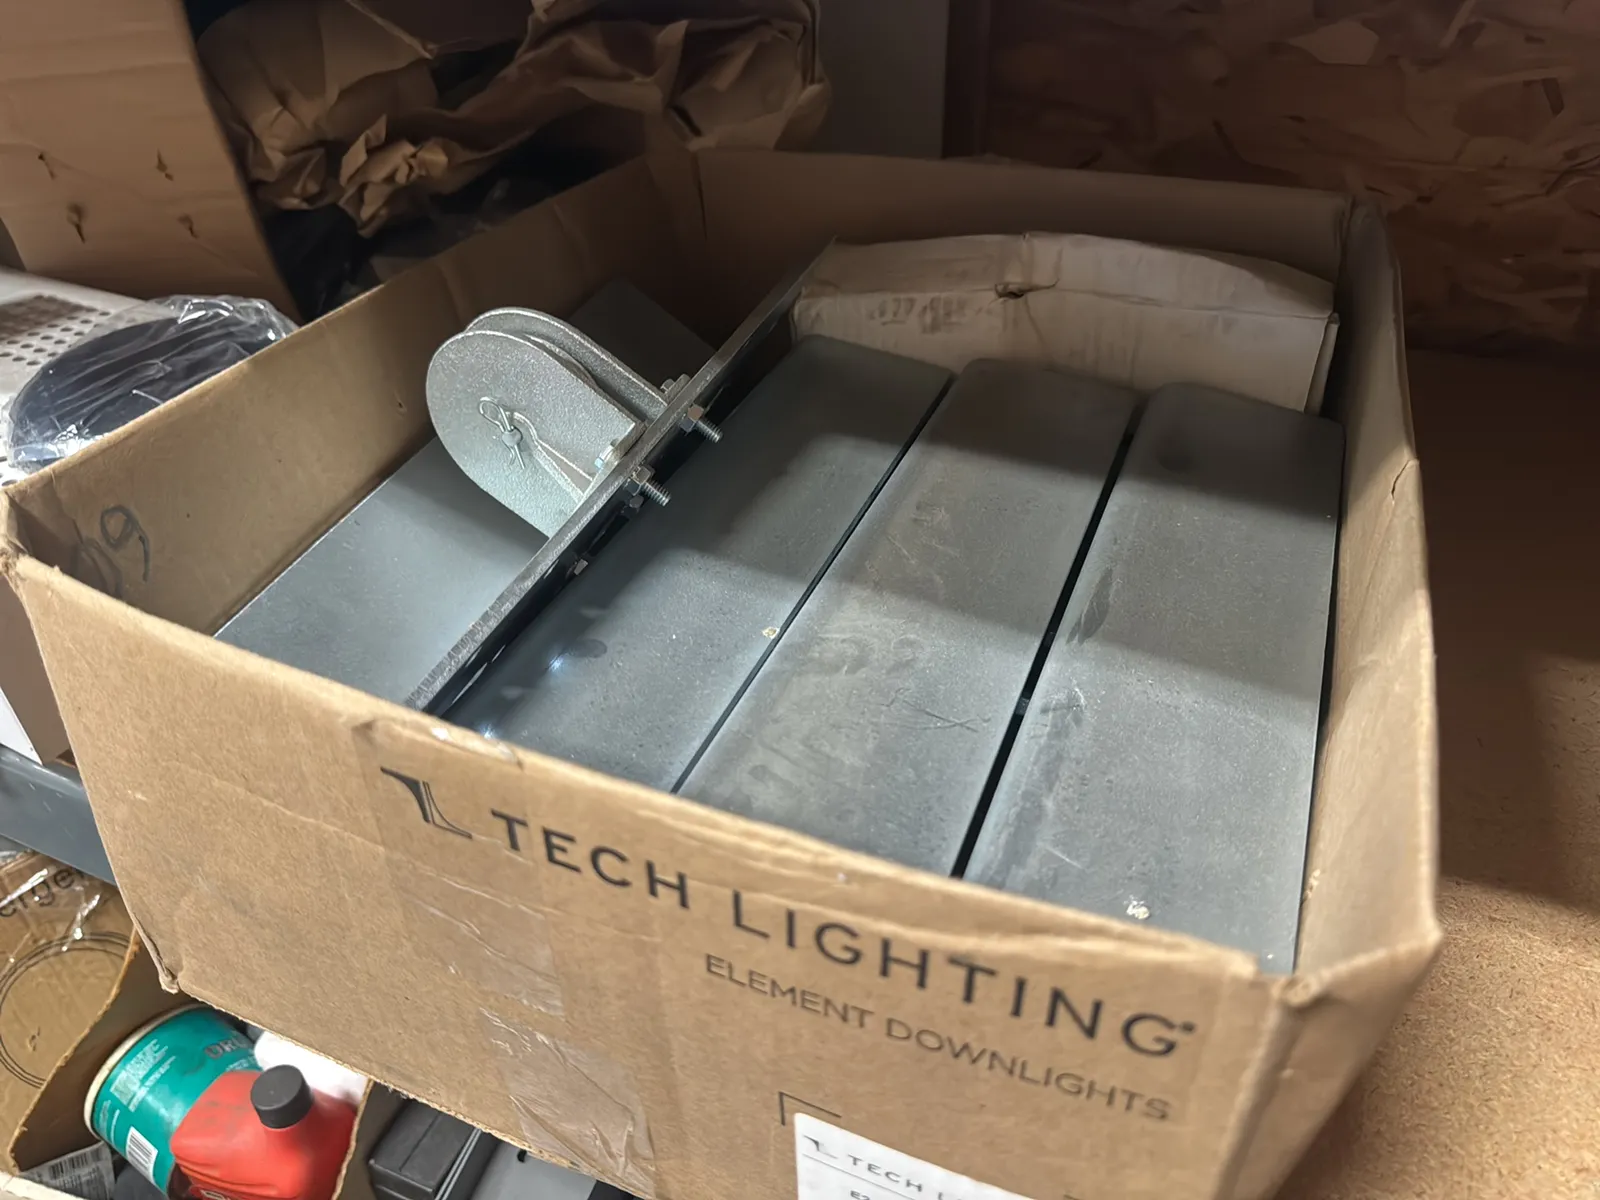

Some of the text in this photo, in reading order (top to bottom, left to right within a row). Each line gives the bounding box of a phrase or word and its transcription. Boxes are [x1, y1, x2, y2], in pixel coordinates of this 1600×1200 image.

[490, 808, 691, 910] TECH
[706, 953, 1172, 1120] ELEMENT DOWNLIGHTS
[848, 1154, 924, 1193] TECH
